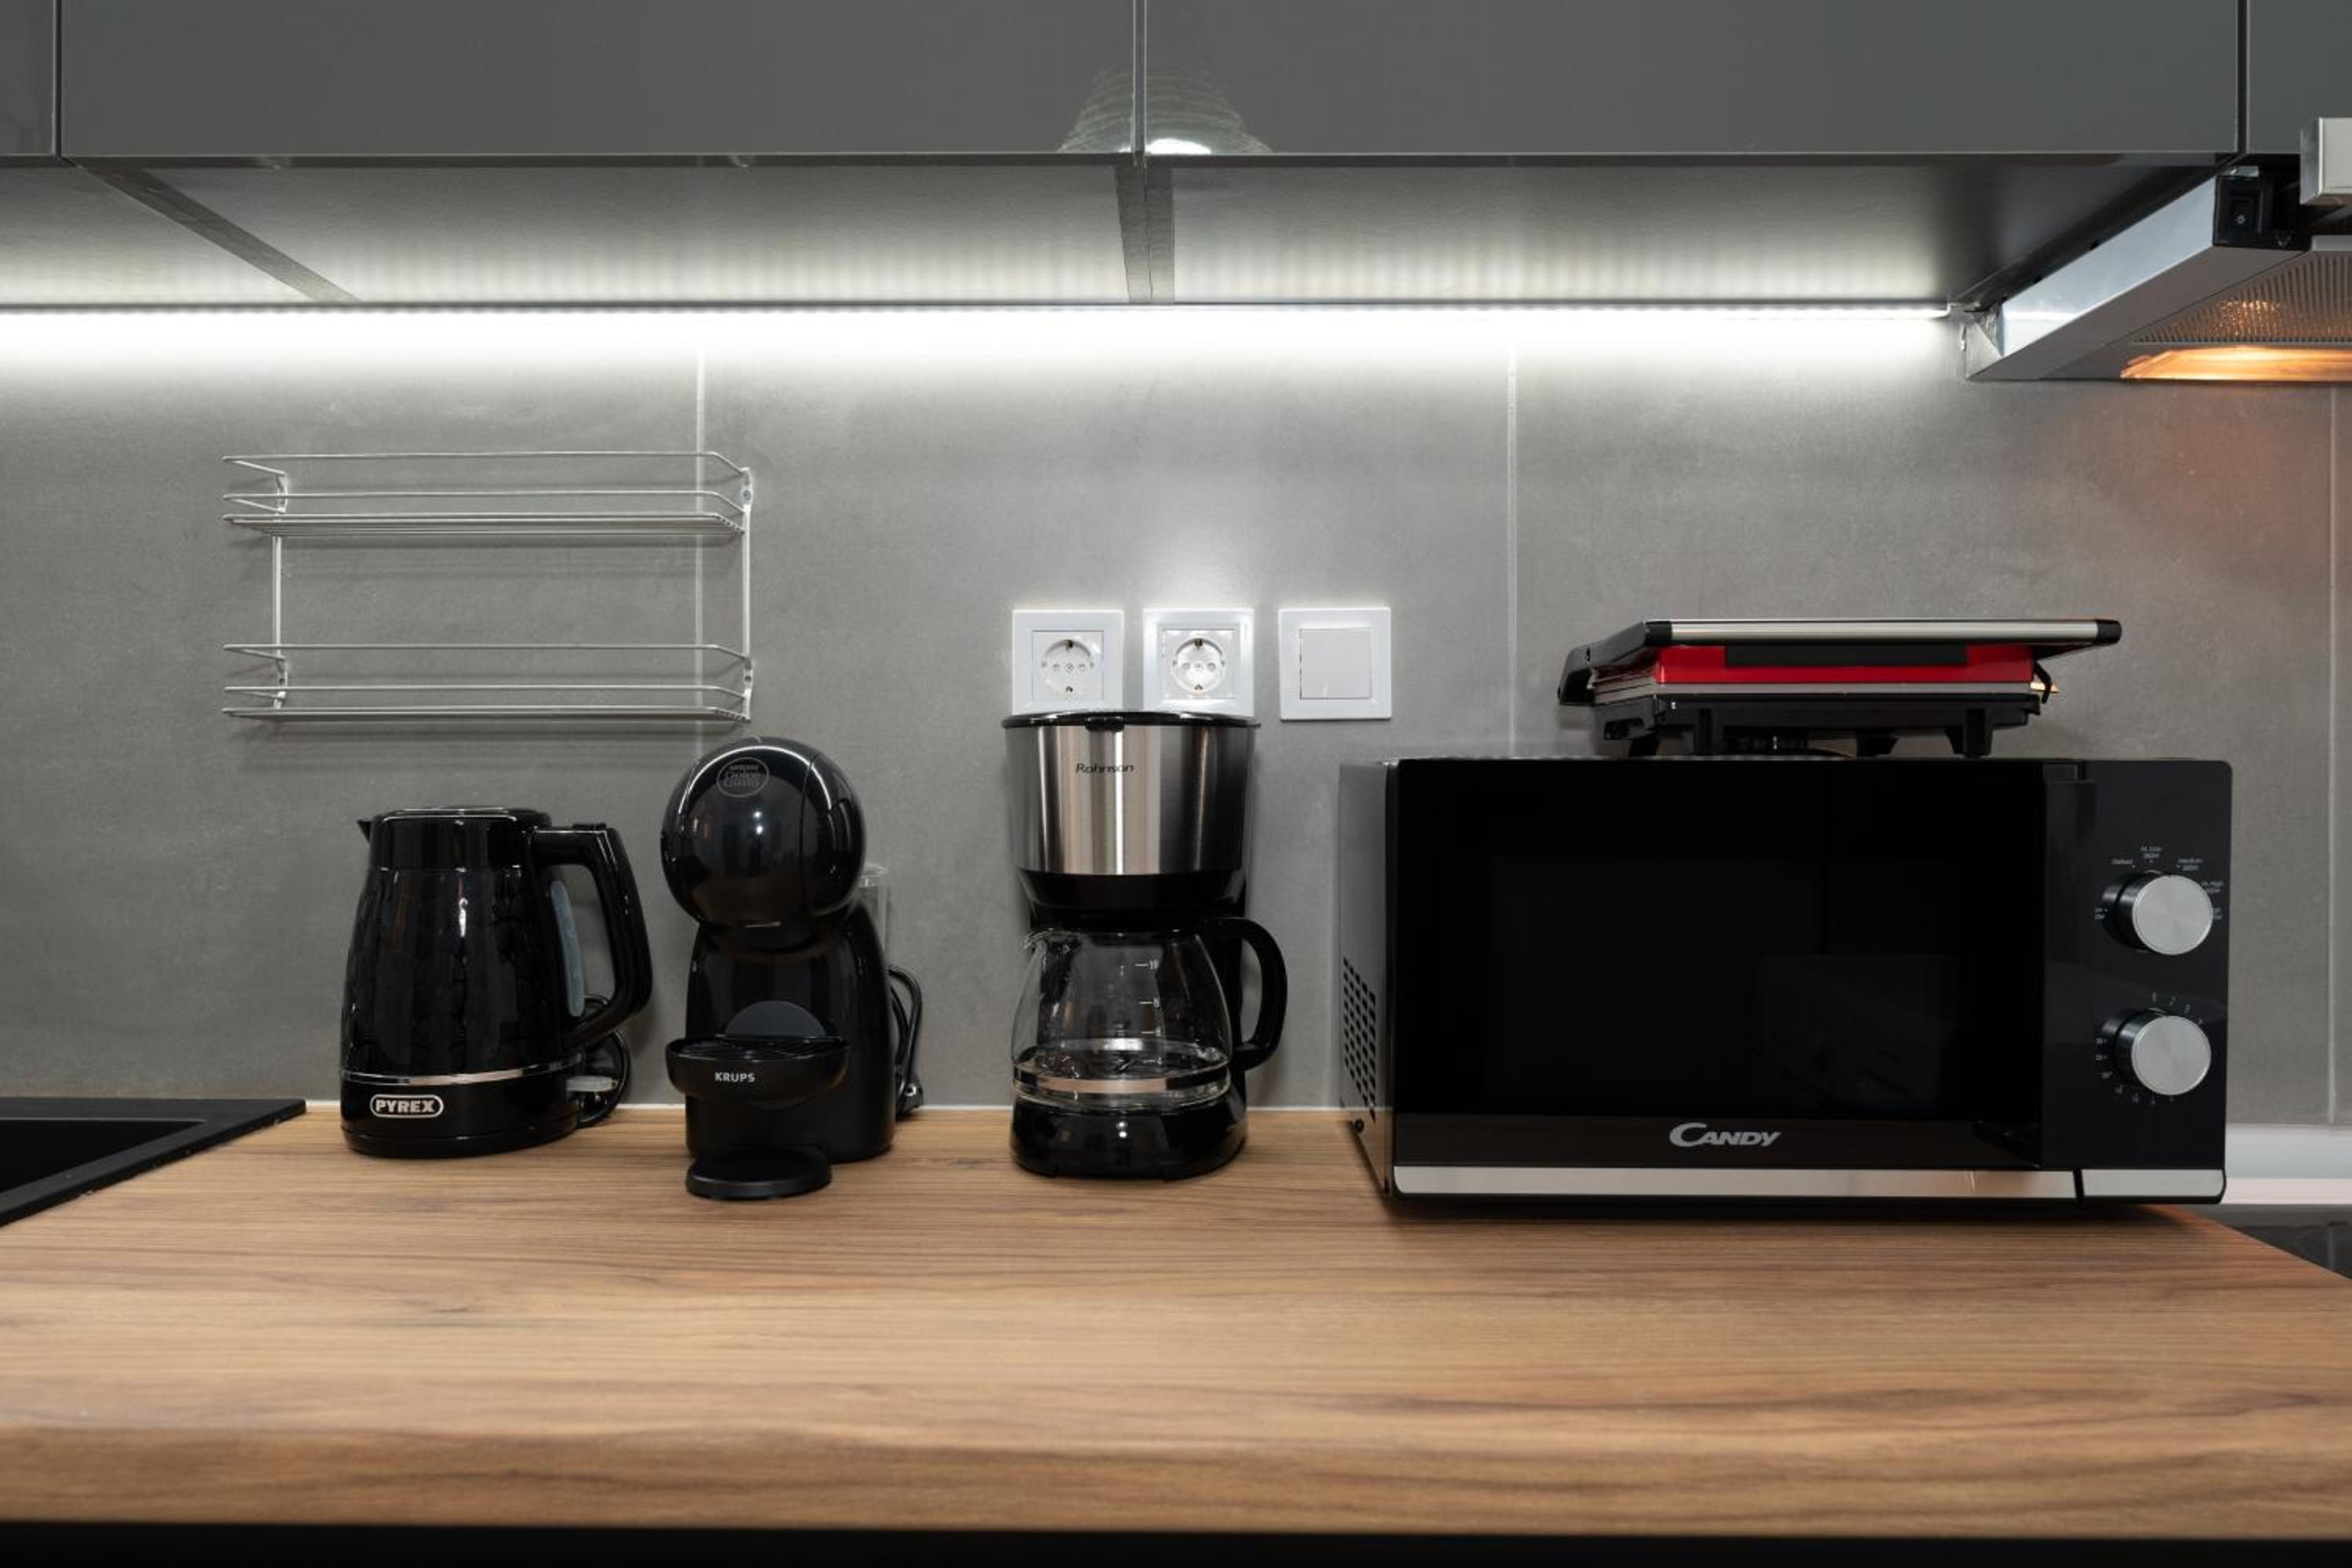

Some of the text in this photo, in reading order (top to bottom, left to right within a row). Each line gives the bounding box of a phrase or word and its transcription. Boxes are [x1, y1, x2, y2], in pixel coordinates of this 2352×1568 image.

[714, 1072, 756, 1083] KRUPS
[376, 1099, 435, 1113] PYREX
[1669, 1122, 1782, 1147] CANDY
